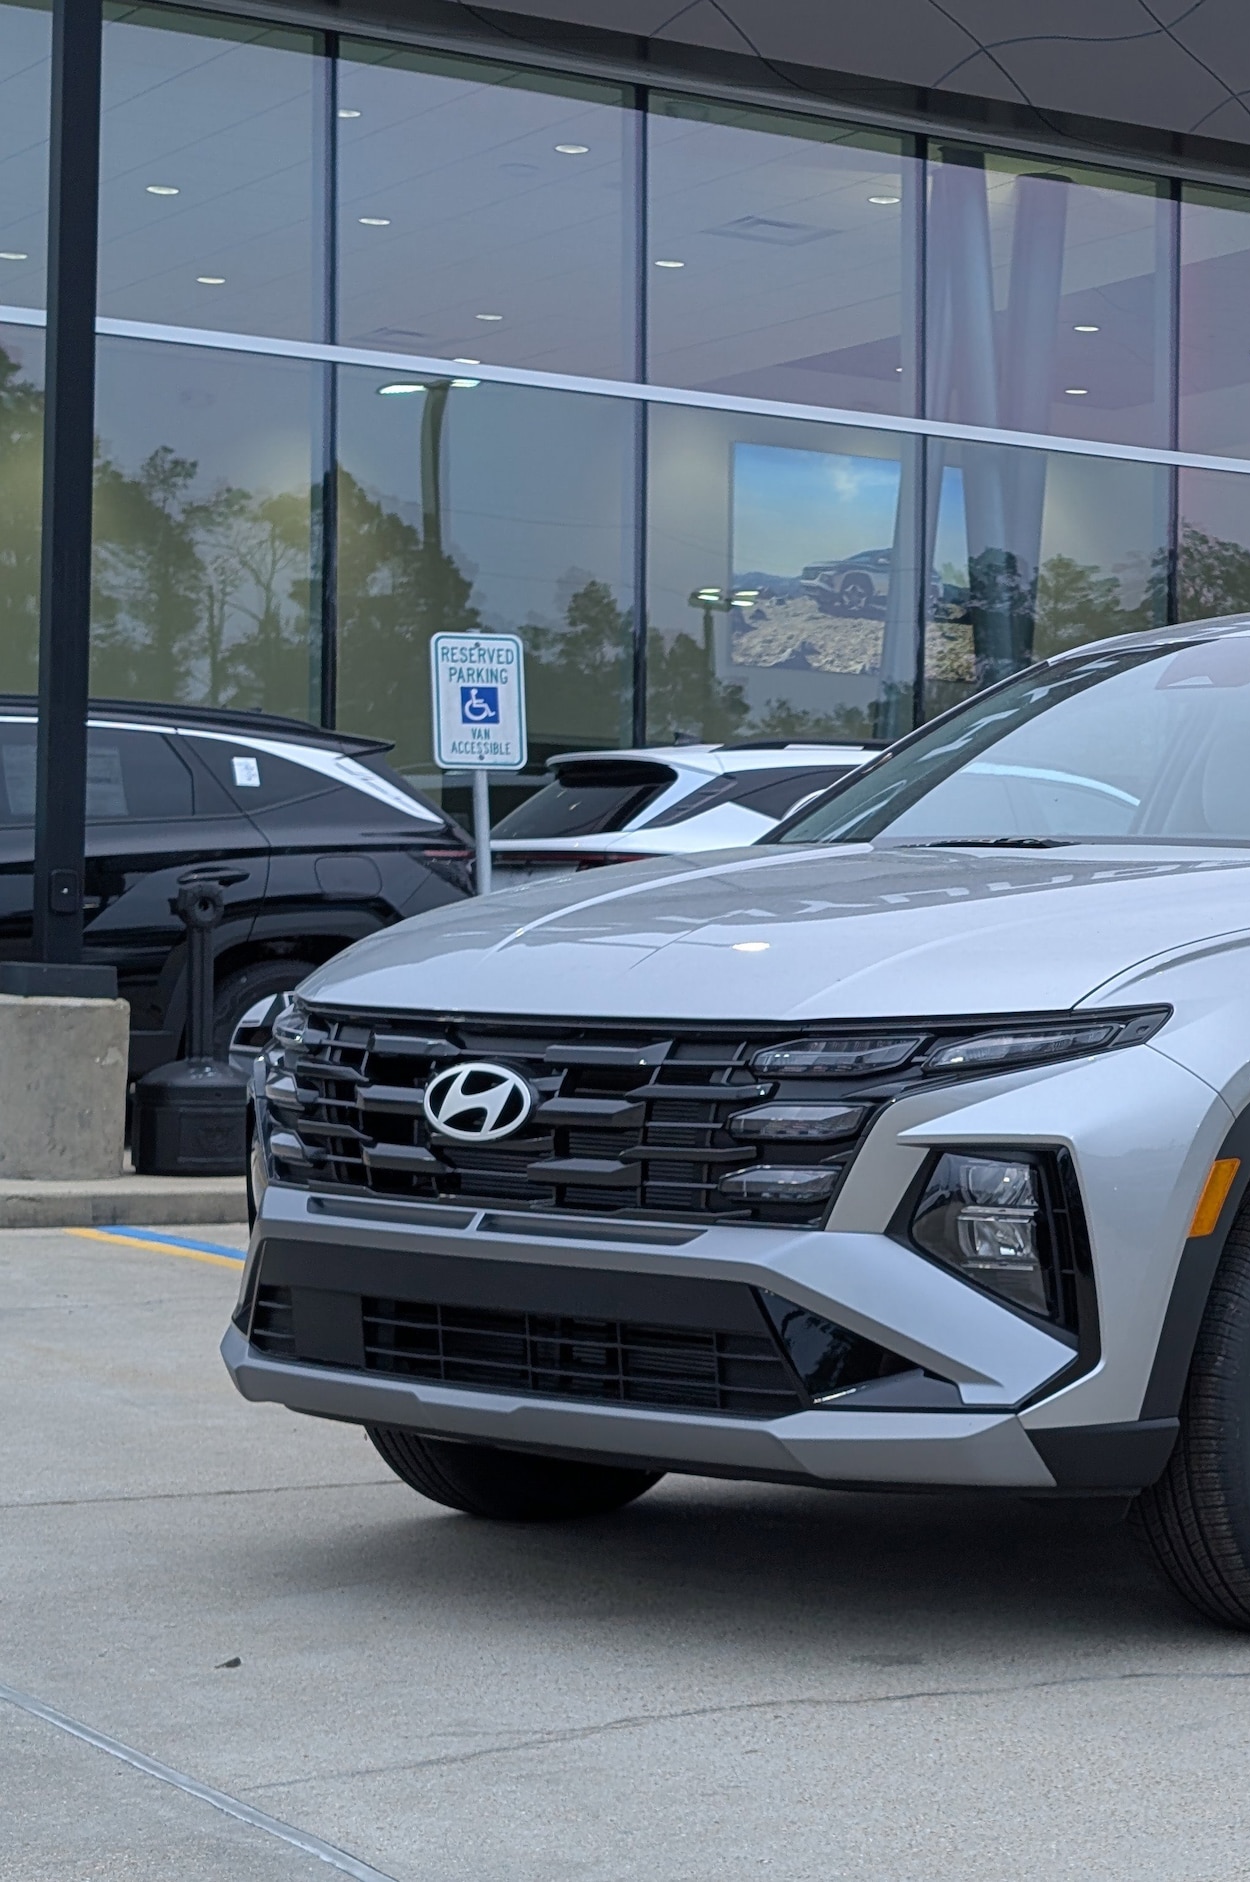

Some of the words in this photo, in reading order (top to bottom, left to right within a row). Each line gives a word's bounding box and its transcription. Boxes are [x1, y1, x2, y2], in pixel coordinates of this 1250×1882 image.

[441, 646, 514, 664] RESERVED
[449, 667, 508, 684] PARKING
[471, 727, 491, 740] VAN
[450, 740, 511, 755] ACCESSIBLE
